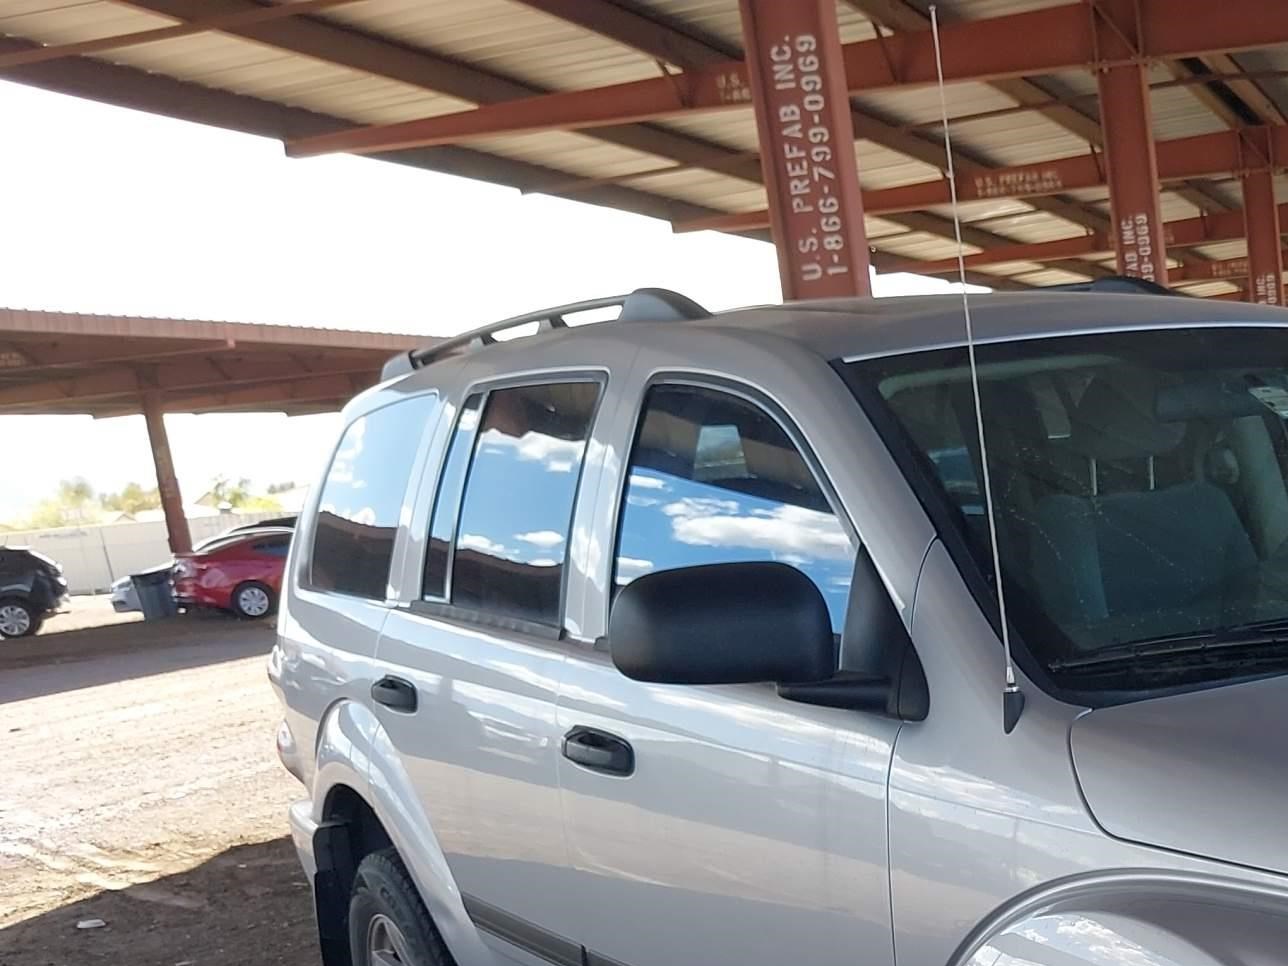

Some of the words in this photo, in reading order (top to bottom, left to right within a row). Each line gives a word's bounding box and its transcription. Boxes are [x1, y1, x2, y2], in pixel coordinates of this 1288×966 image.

[770, 35, 797, 90] INC.
[778, 103, 815, 214] PREFAB
[795, 34, 848, 276] 1-866-799-0969
[800, 227, 823, 281] U.S.
